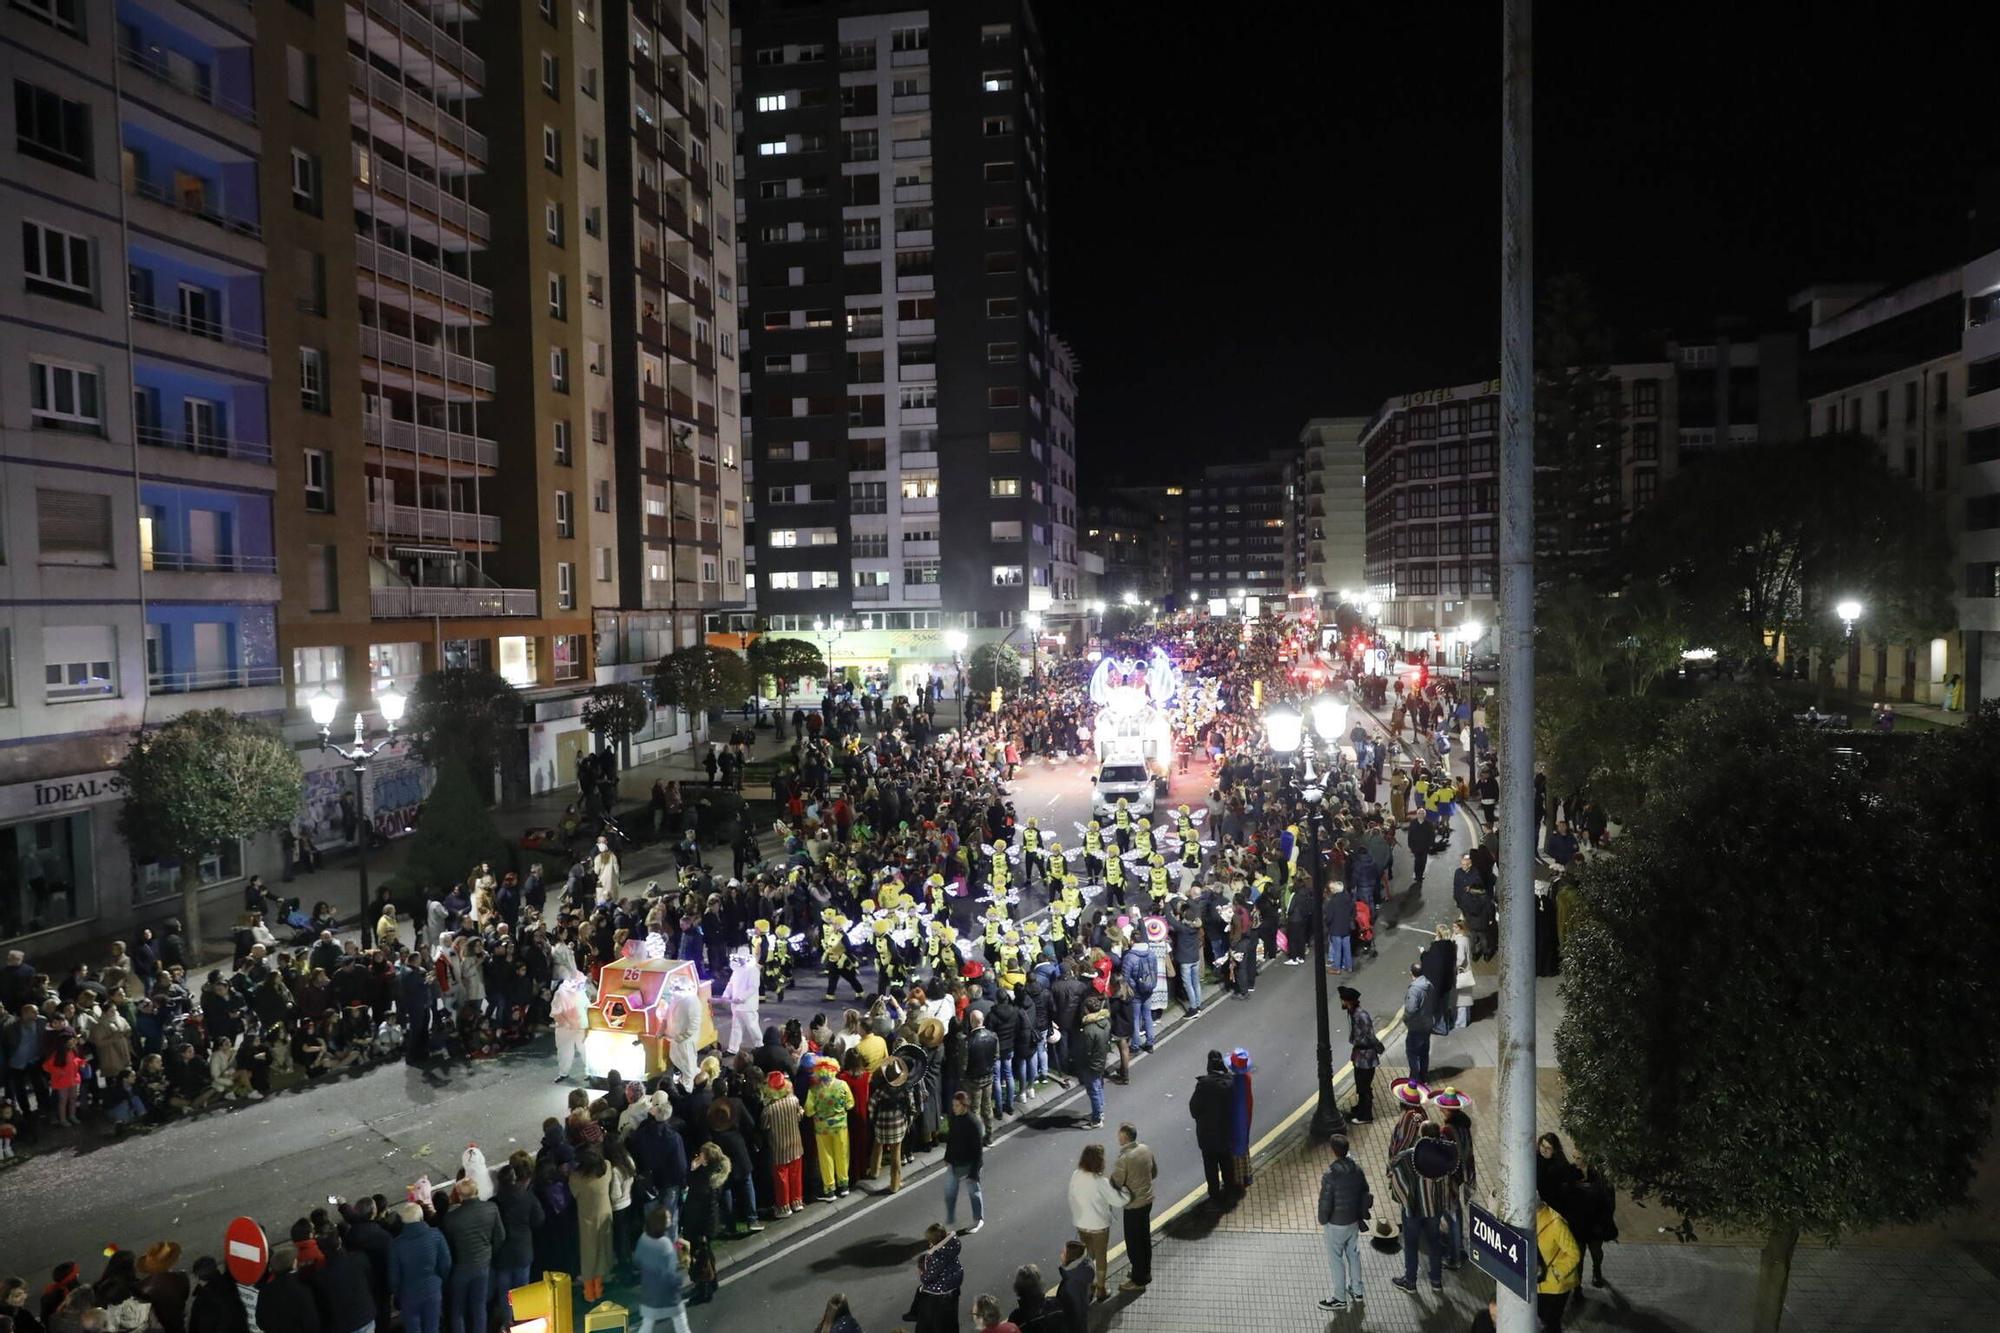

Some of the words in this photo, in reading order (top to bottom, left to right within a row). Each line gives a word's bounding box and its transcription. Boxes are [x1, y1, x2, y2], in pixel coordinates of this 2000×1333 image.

[1401, 386, 1455, 407] HOTEL
[1481, 378, 1501, 394] BE
[624, 968, 640, 980] 26
[1473, 1216, 1518, 1264] ZONA-4
